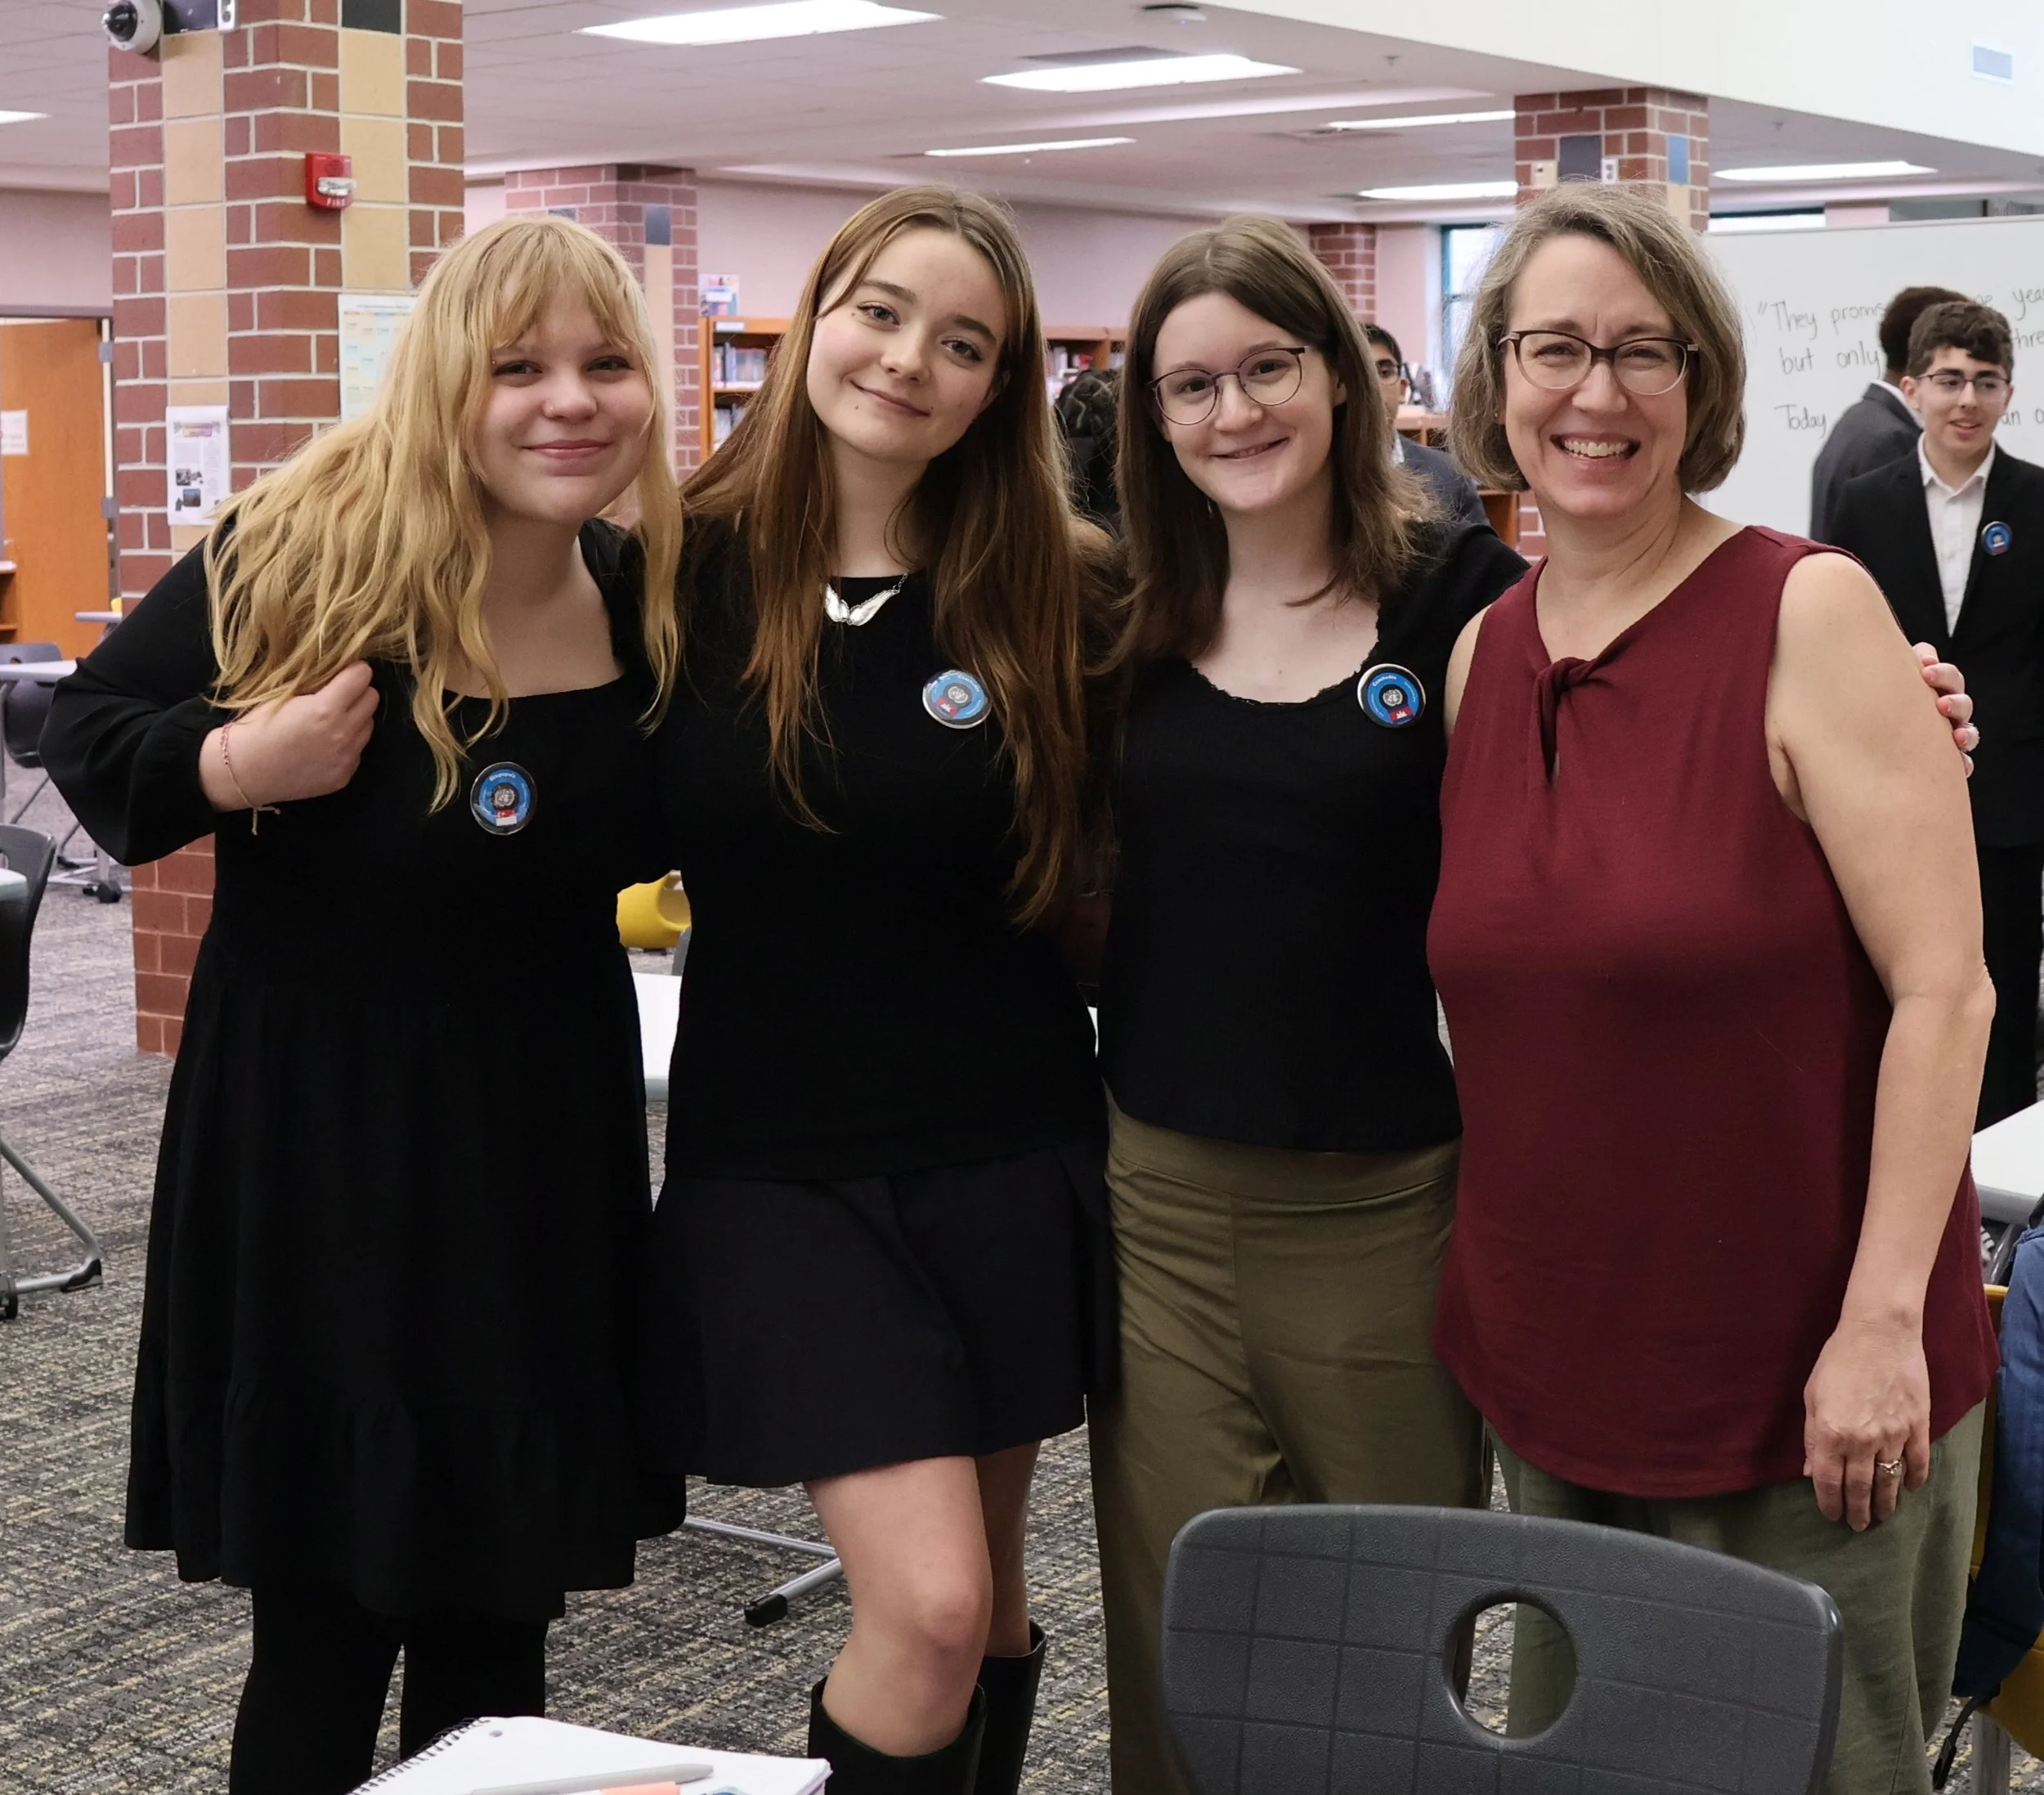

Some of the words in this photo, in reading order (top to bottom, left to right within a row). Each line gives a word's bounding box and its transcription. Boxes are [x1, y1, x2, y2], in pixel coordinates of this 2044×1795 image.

[2012, 289, 2044, 321] yea
[1779, 346, 1814, 375] but
[1837, 340, 1880, 379] only
[1773, 404, 1827, 439] Today
